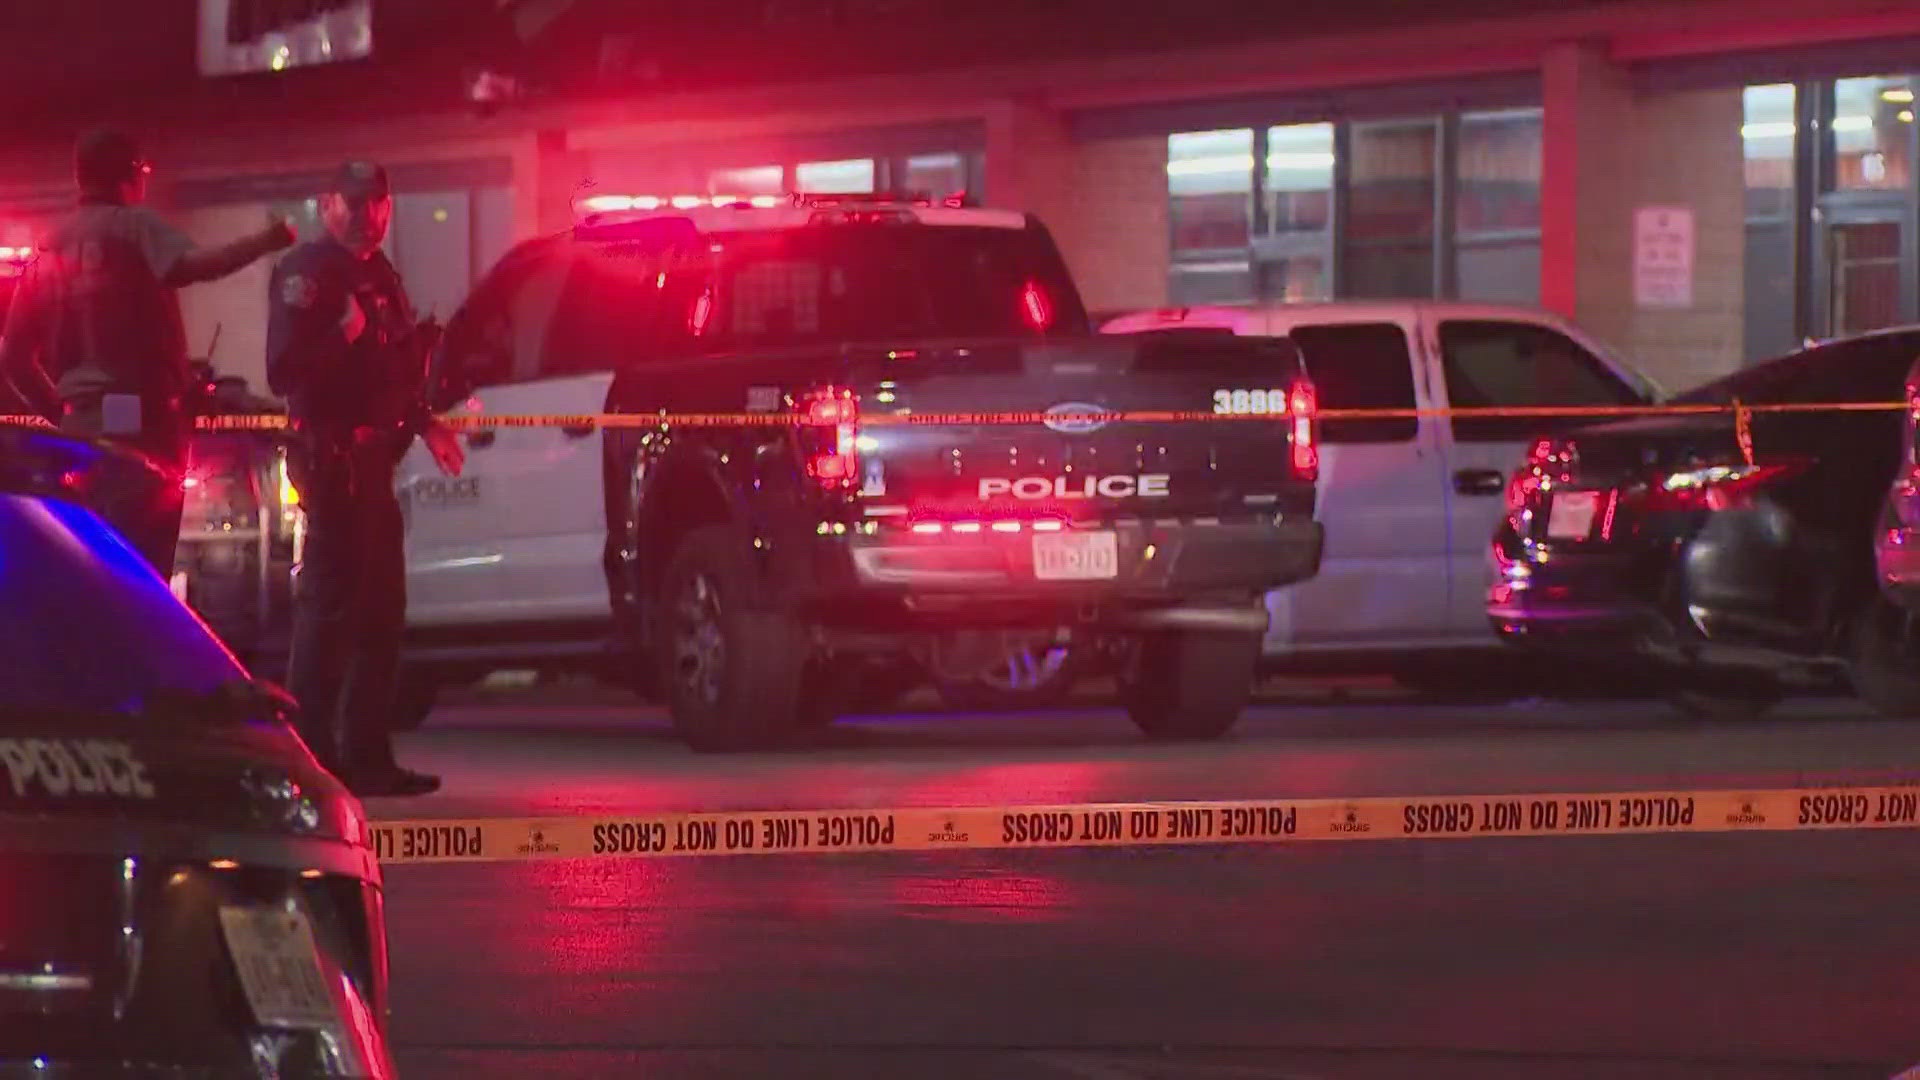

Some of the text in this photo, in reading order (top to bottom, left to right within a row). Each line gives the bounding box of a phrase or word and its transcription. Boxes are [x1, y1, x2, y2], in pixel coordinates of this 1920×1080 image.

[978, 475, 1170, 500] POLICE
[1, 738, 155, 798] POLICE
[1002, 805, 1297, 843] POLICE LINE DO NOT CROSS
[1403, 797, 1695, 833] POLICE LINE DO NOT CROSS
[1799, 793, 1917, 824] CROSS NOT
[368, 827, 482, 858] POLICE LI
[593, 815, 895, 853] POLICE LINE DO NOT CROSS
